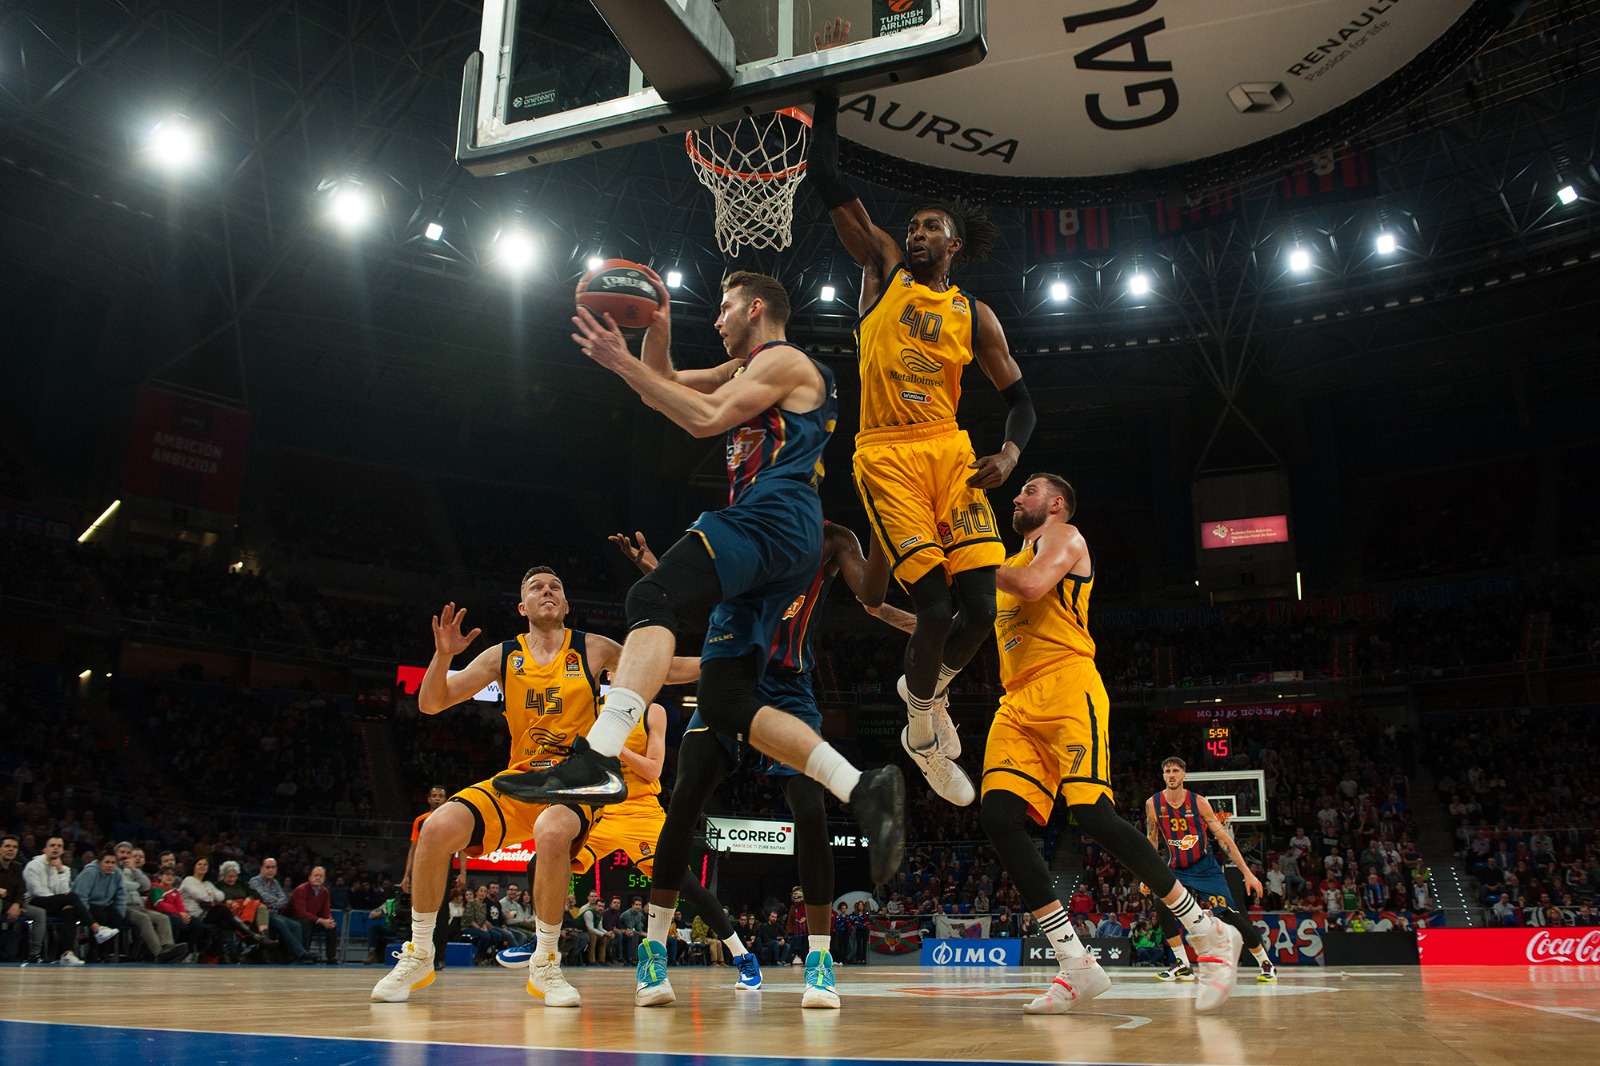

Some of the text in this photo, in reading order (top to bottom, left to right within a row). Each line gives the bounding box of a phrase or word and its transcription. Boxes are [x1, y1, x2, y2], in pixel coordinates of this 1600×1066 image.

[879, 15, 924, 33] AIRLINES
[880, 8, 924, 24] TURKISH
[1286, 0, 1399, 76] RENAUL
[1305, 20, 1391, 80] Passion for life
[1059, 207, 1080, 237] 8
[900, 303, 943, 343] 40
[889, 371, 944, 388] Metalloinvest
[152, 431, 223, 460] AMBICIÓN
[951, 502, 993, 537] 40
[525, 686, 563, 717] 45
[1208, 727, 1229, 739] 5:54
[1065, 744, 1087, 775] 7
[1170, 817, 1188, 832] 33
[710, 827, 786, 843] EL CORREO
[613, 851, 629, 866] 33
[954, 947, 1008, 966] IMQ
[1030, 947, 1102, 960] KEE
